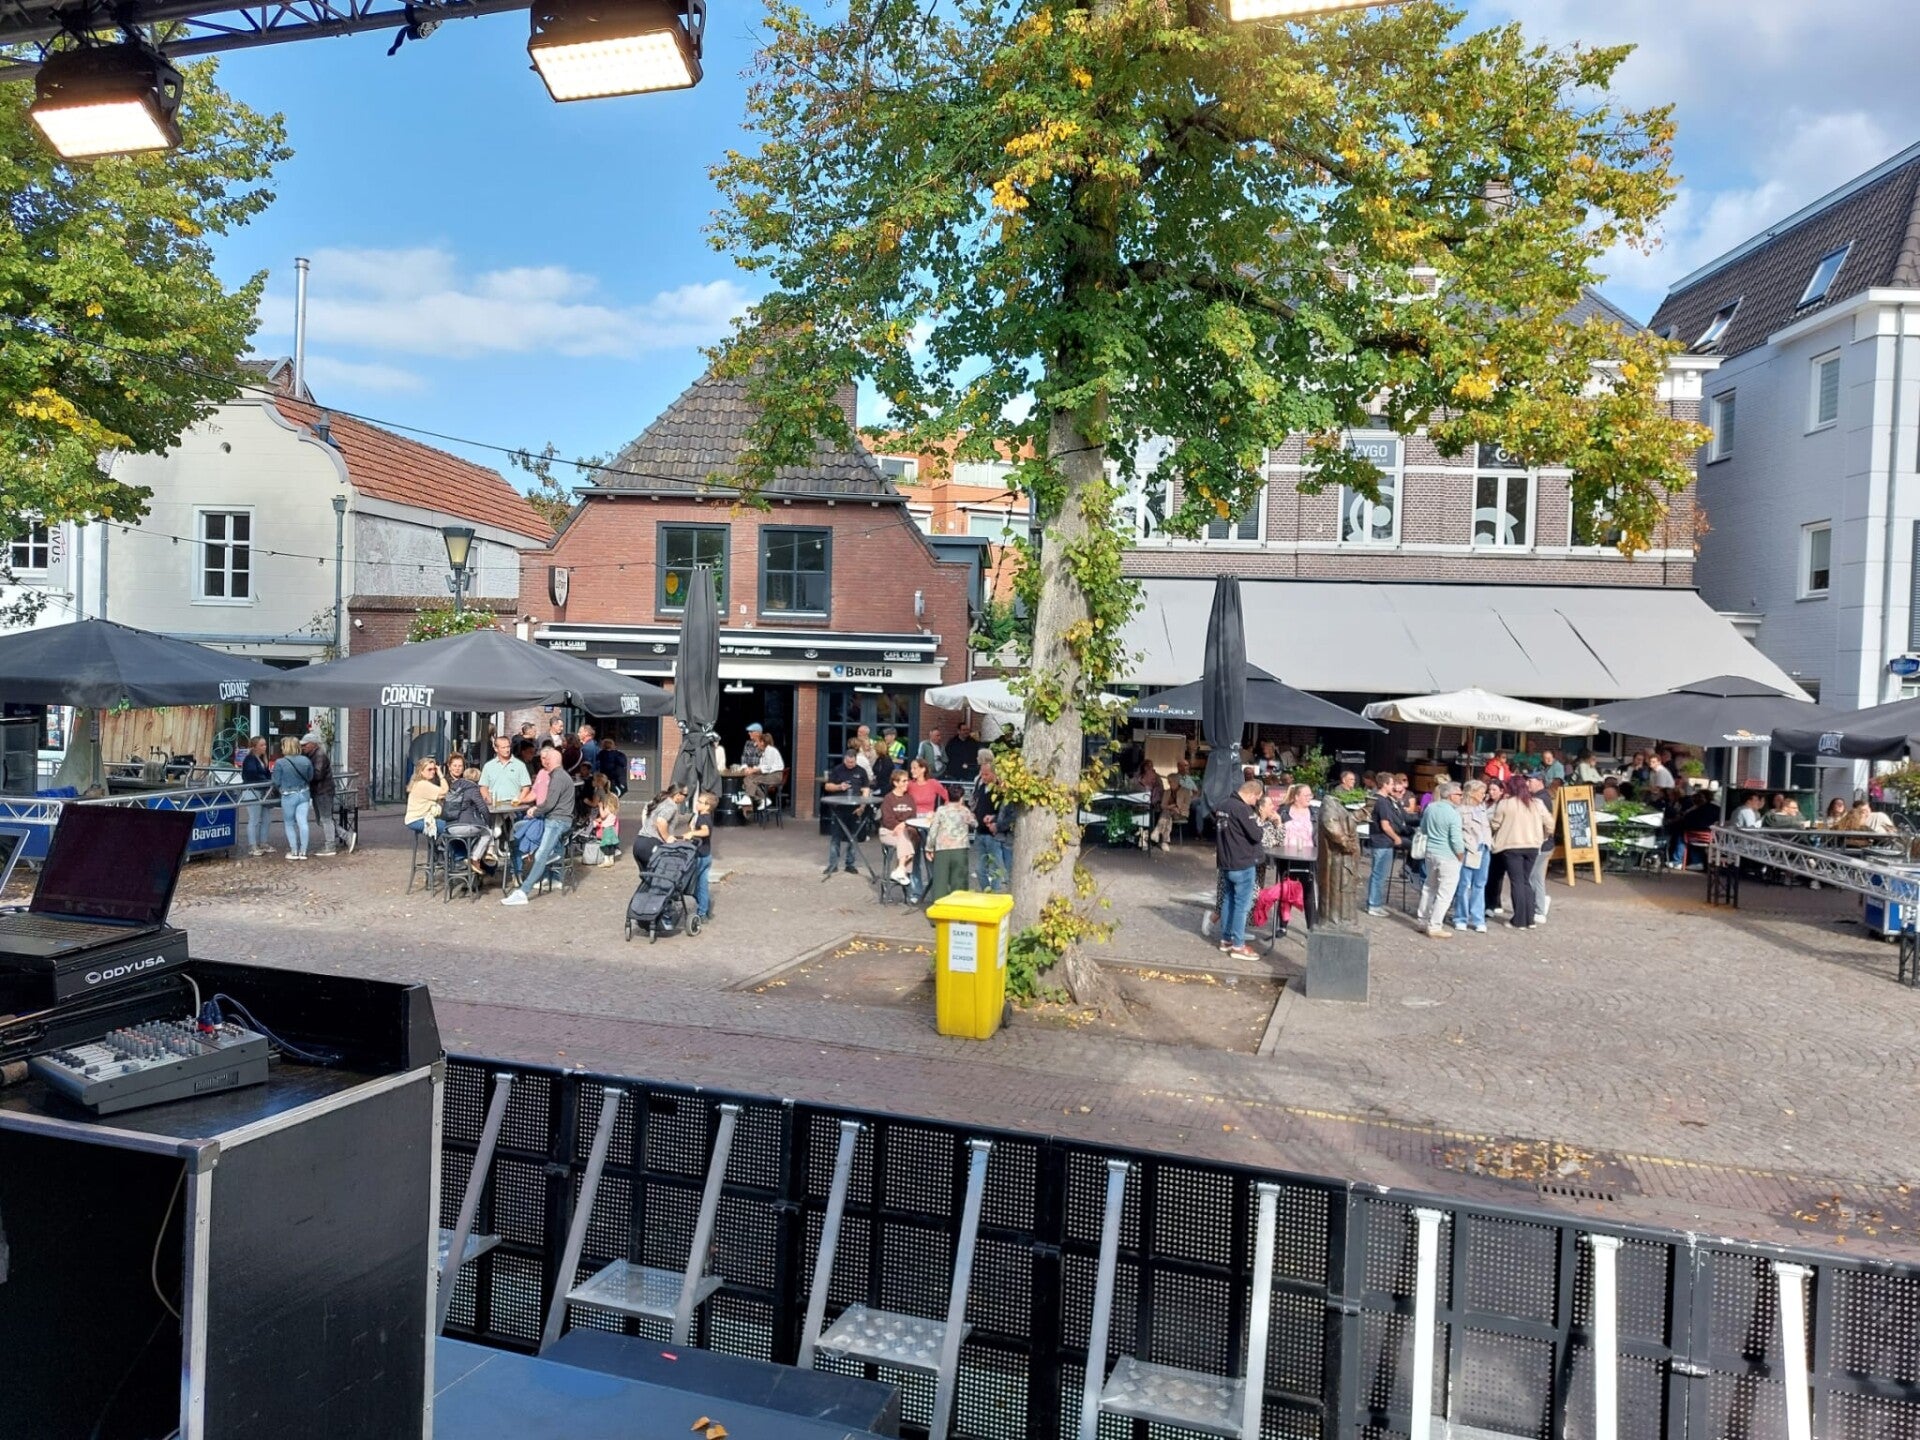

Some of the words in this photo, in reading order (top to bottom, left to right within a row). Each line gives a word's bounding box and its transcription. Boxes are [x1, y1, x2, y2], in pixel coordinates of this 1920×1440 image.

[846, 665, 893, 678] Bavaria
[381, 686, 434, 708] CORNET
[192, 824, 231, 841] Bavaria
[102, 955, 166, 980] ODYUSA
